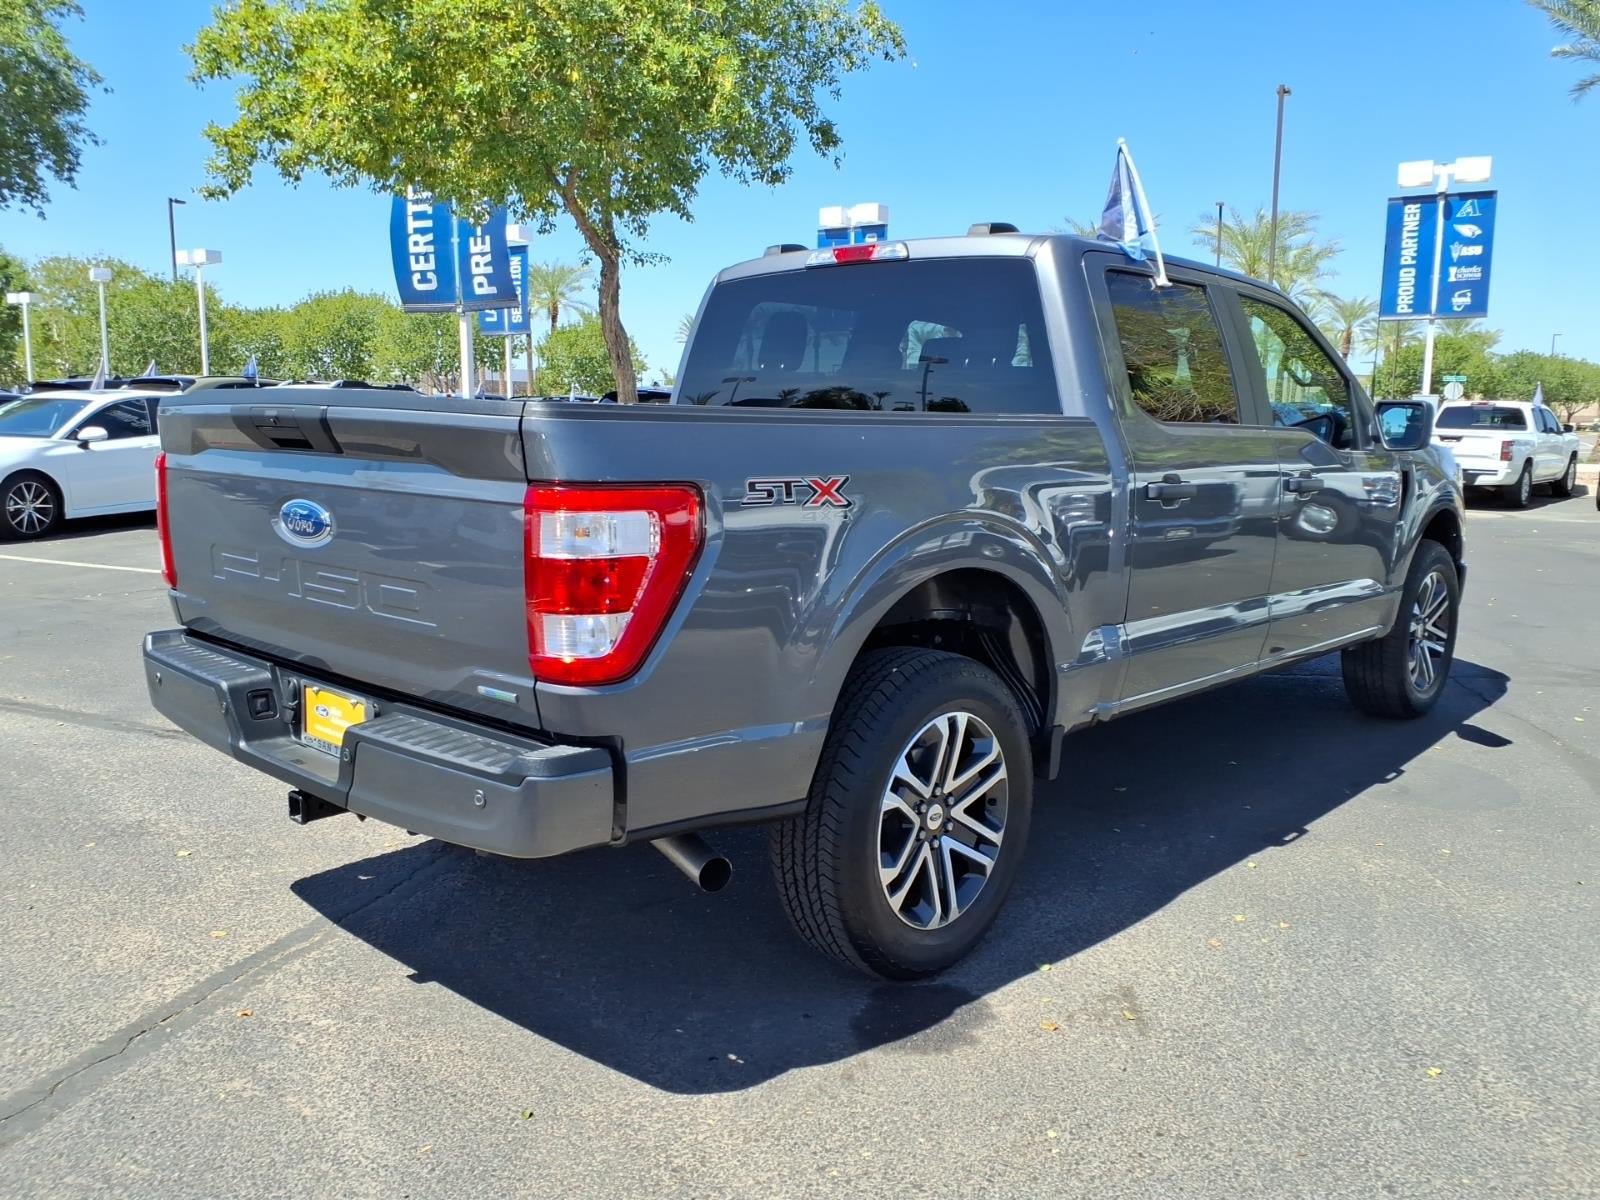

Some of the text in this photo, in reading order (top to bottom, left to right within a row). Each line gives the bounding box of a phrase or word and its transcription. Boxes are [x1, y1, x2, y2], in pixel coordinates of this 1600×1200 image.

[407, 184, 438, 291] CERTIF
[1397, 203, 1421, 313] PROUD PARTNER
[510, 256, 522, 323] SECTION
[287, 507, 316, 533] Ford
[741, 476, 853, 511] STX
